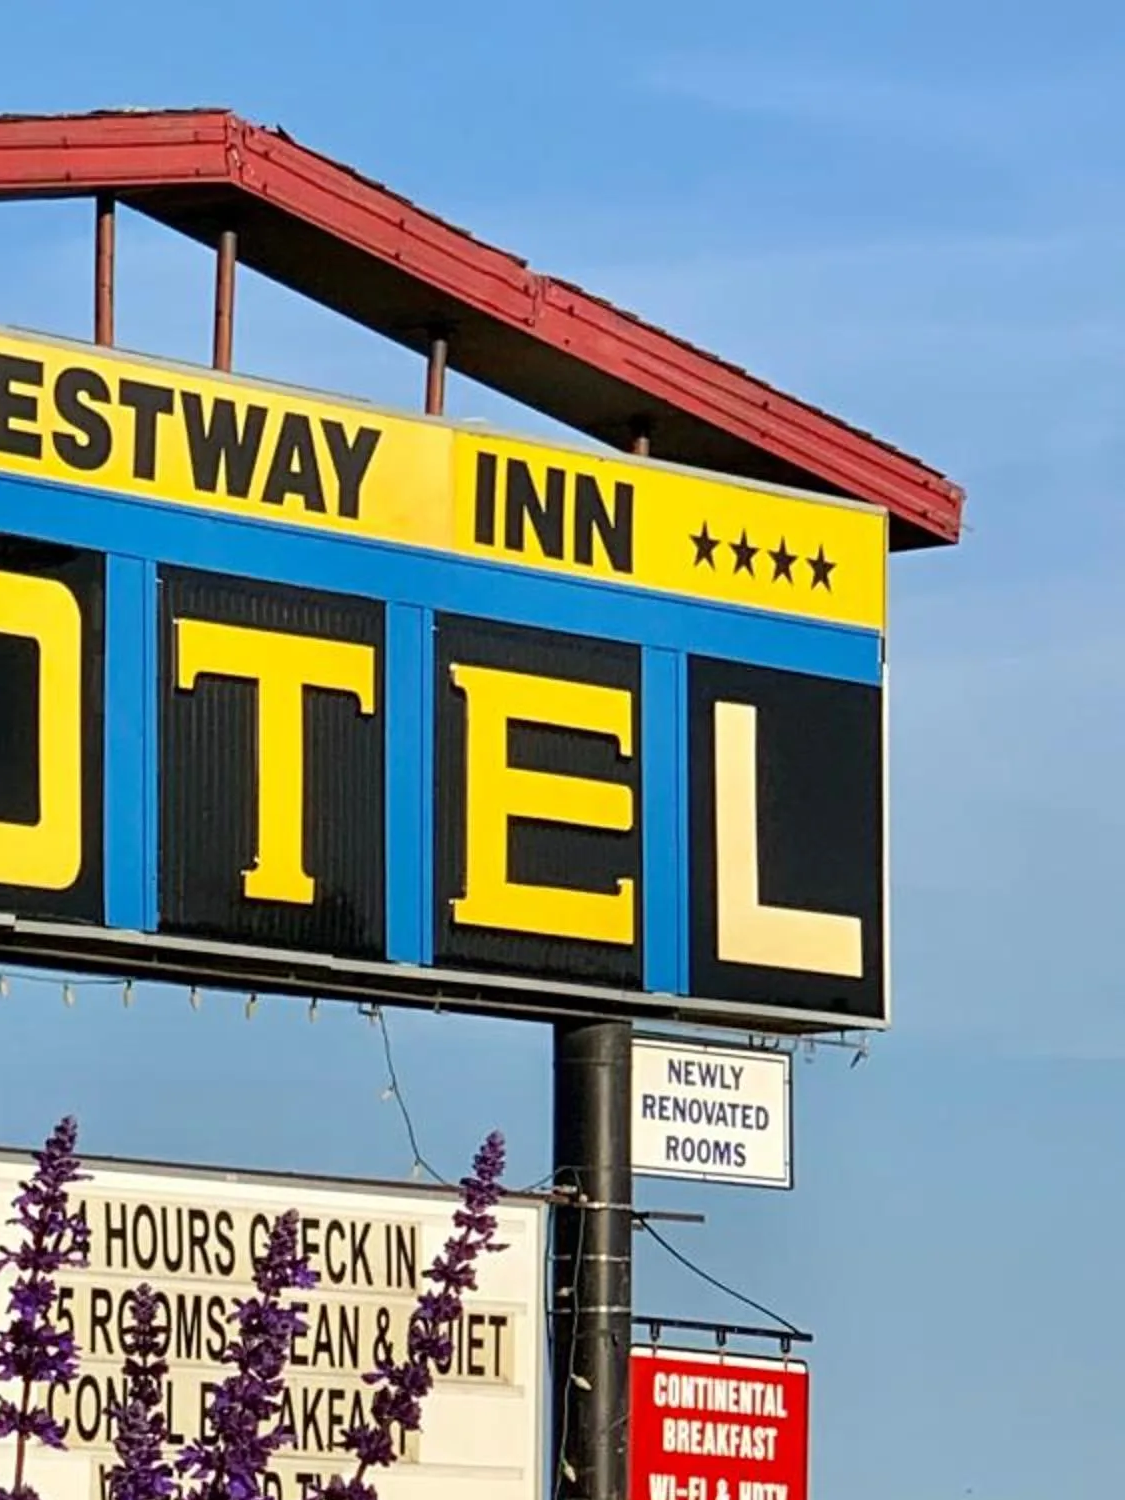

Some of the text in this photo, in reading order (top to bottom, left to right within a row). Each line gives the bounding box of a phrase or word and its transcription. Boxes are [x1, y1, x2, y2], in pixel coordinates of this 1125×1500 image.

[474, 451, 635, 574] INN
[666, 1058, 744, 1092] NEWLY
[641, 1093, 770, 1131] RENOVATED
[665, 1135, 747, 1168] ROOMS
[105, 1201, 236, 1277] HOURS
[249, 1213, 374, 1286] CECK
[385, 1223, 417, 1289] IN
[90, 1287, 226, 1362] ROOMS
[243, 1300, 360, 1369] EAN
[374, 1306, 396, 1368] &
[48, 1375, 414, 1456] CONL BAKFA
[652, 1371, 788, 1418] CONTINENTAL
[661, 1418, 778, 1461] BREAKFAST
